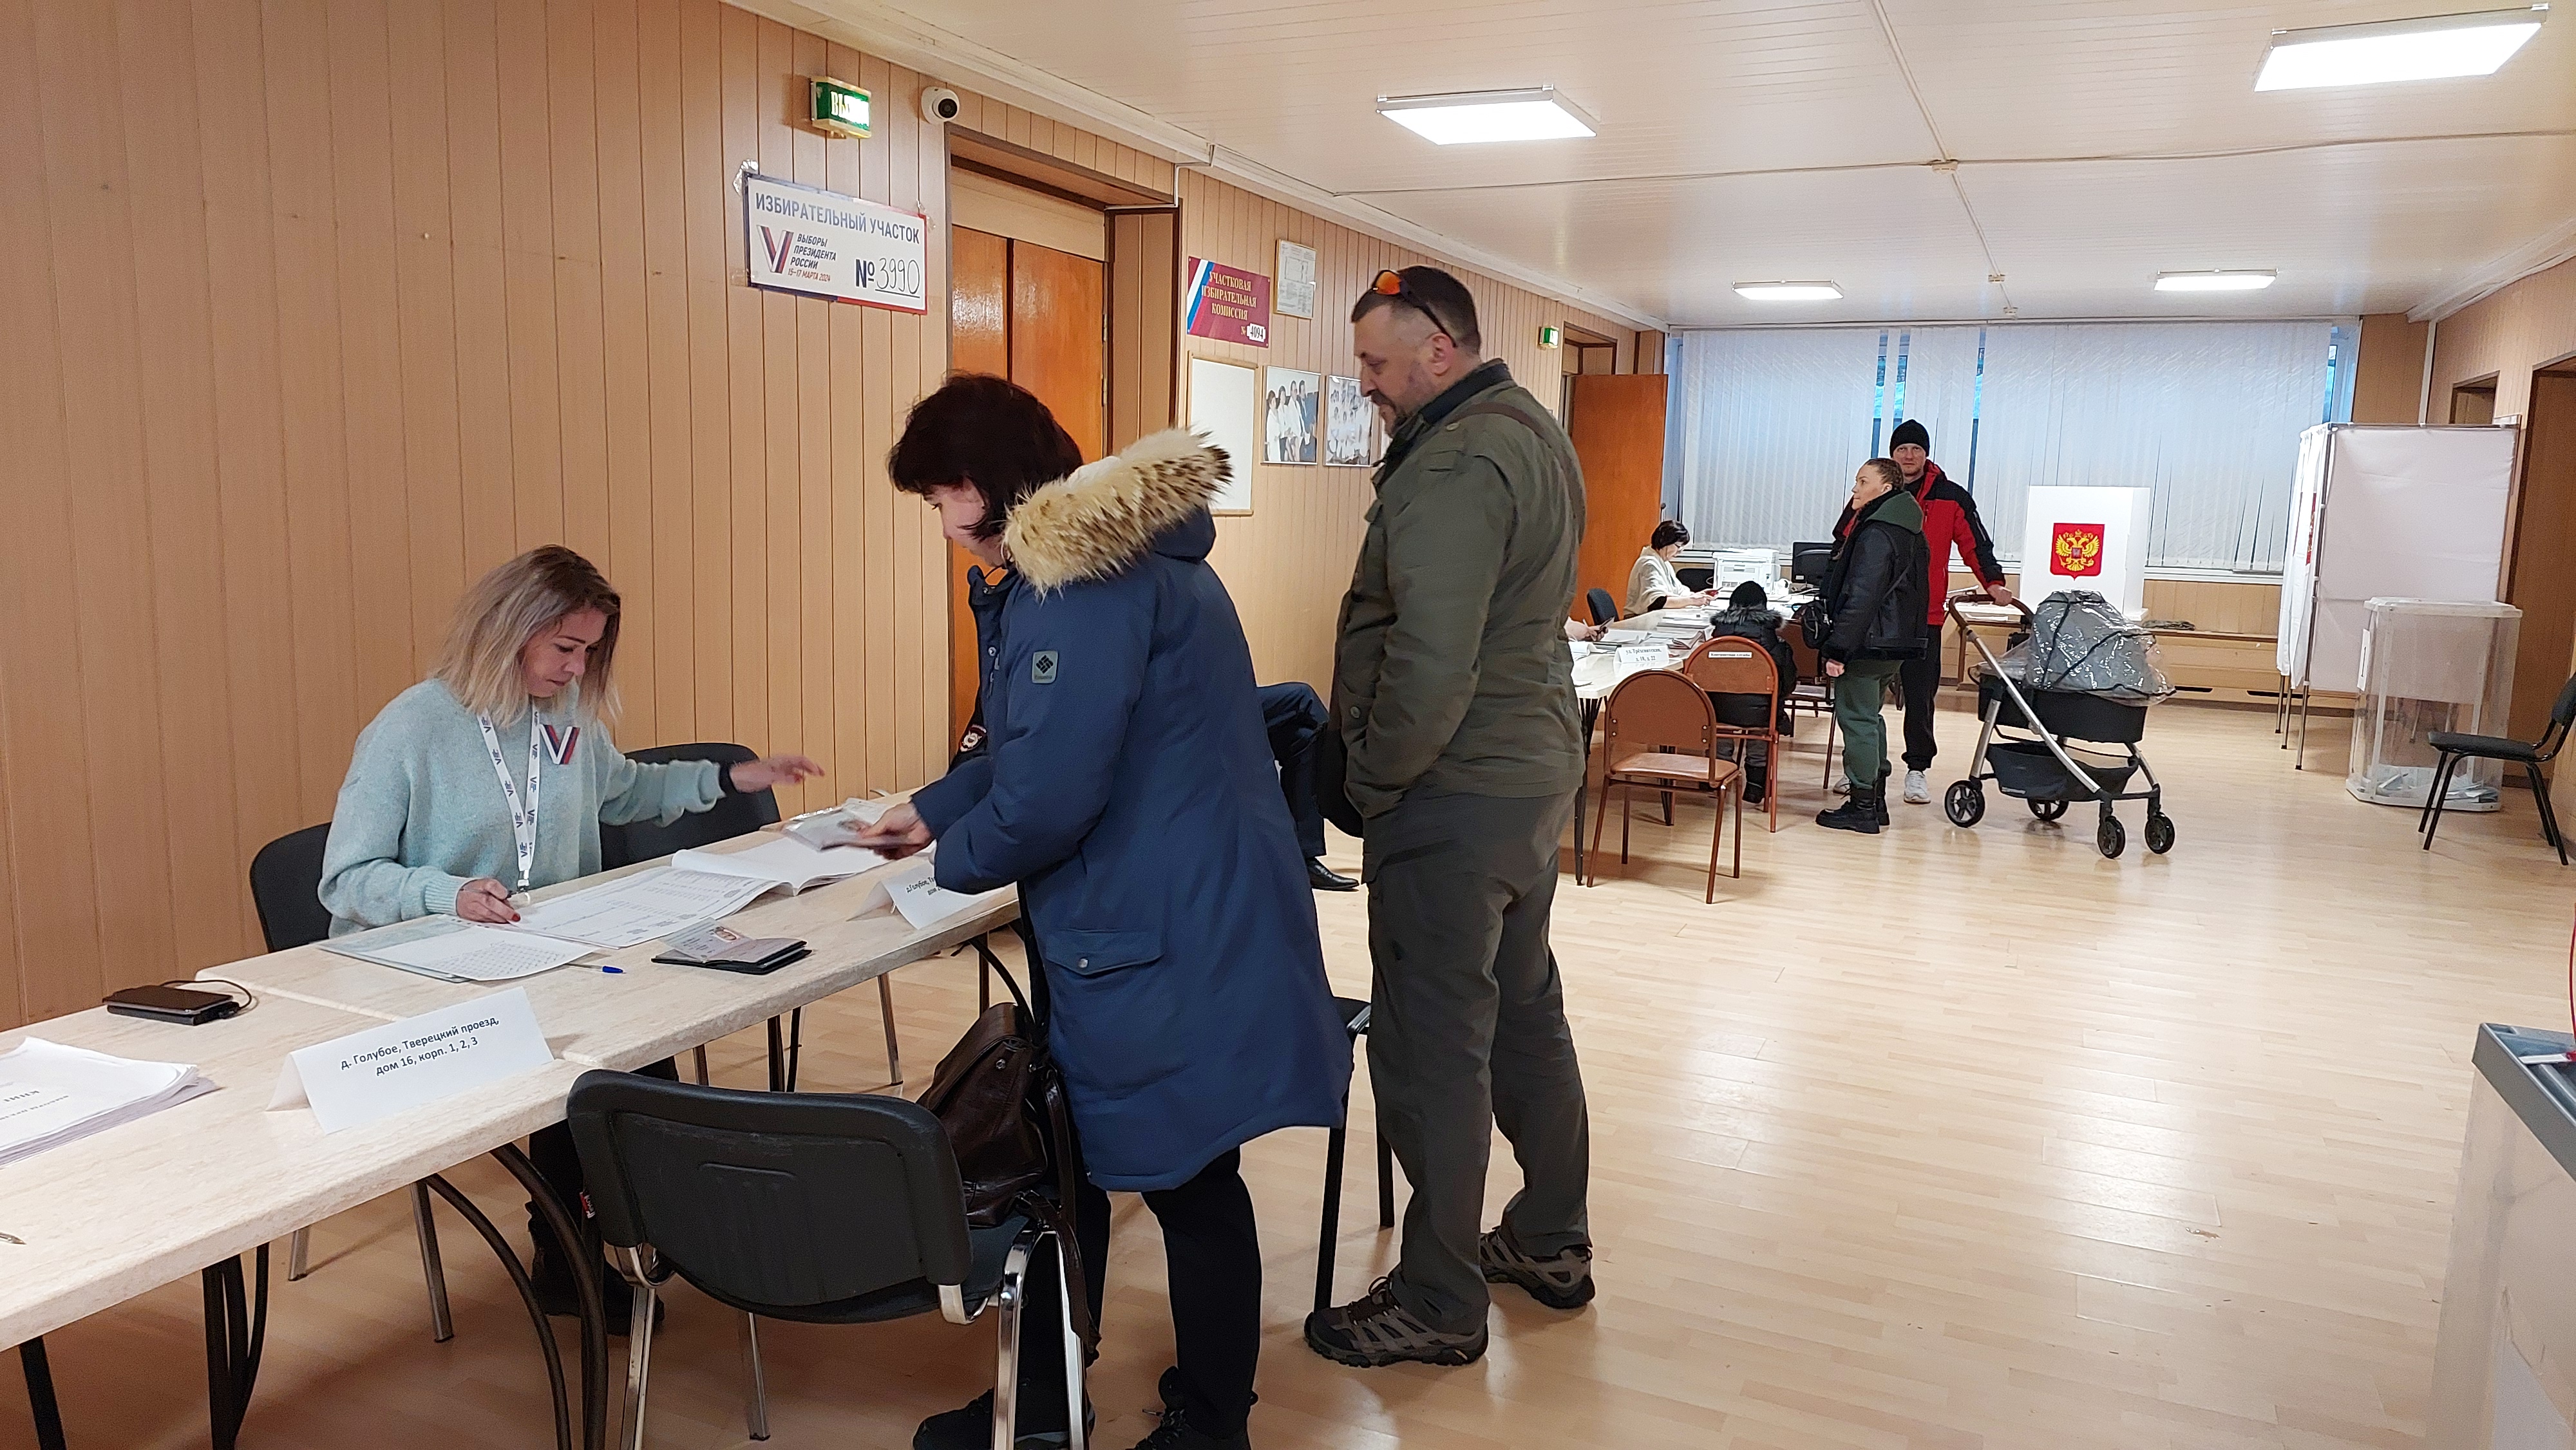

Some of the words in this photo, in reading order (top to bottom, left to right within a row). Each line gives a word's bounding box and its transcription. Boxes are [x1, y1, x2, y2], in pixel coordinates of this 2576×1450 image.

[755, 193, 867, 232] ИЗБИРАТЕЛЬНЫЙ
[869, 218, 920, 245] УЧАСТОК
[797, 233, 828, 247] ВЫБОРЫ
[790, 256, 819, 269] РОССИИ
[793, 245, 837, 261] ПРЕЗИДЕНТА
[802, 271, 819, 281] МАРТА
[819, 273, 831, 282] 2024
[876, 258, 920, 295] 3990
[1209, 271, 1251, 292] УЧАСТКОВАЯ
[1201, 285, 1257, 308] ИЗБИРАТЕЛЬНАЯ
[1211, 303, 1248, 321] КОМИССИЯ
[341, 1060, 352, 1070] д.
[353, 1046, 402, 1064] Голубое,
[402, 1026, 459, 1050] Тверецкий
[460, 1017, 500, 1033] проезд,
[376, 1062, 399, 1077] дом
[400, 1055, 417, 1067] 16,
[418, 1048, 448, 1062] корп.
[448, 1043, 459, 1053] 1,
[459, 1040, 470, 1050] 2,
[470, 1037, 478, 1046] 3
